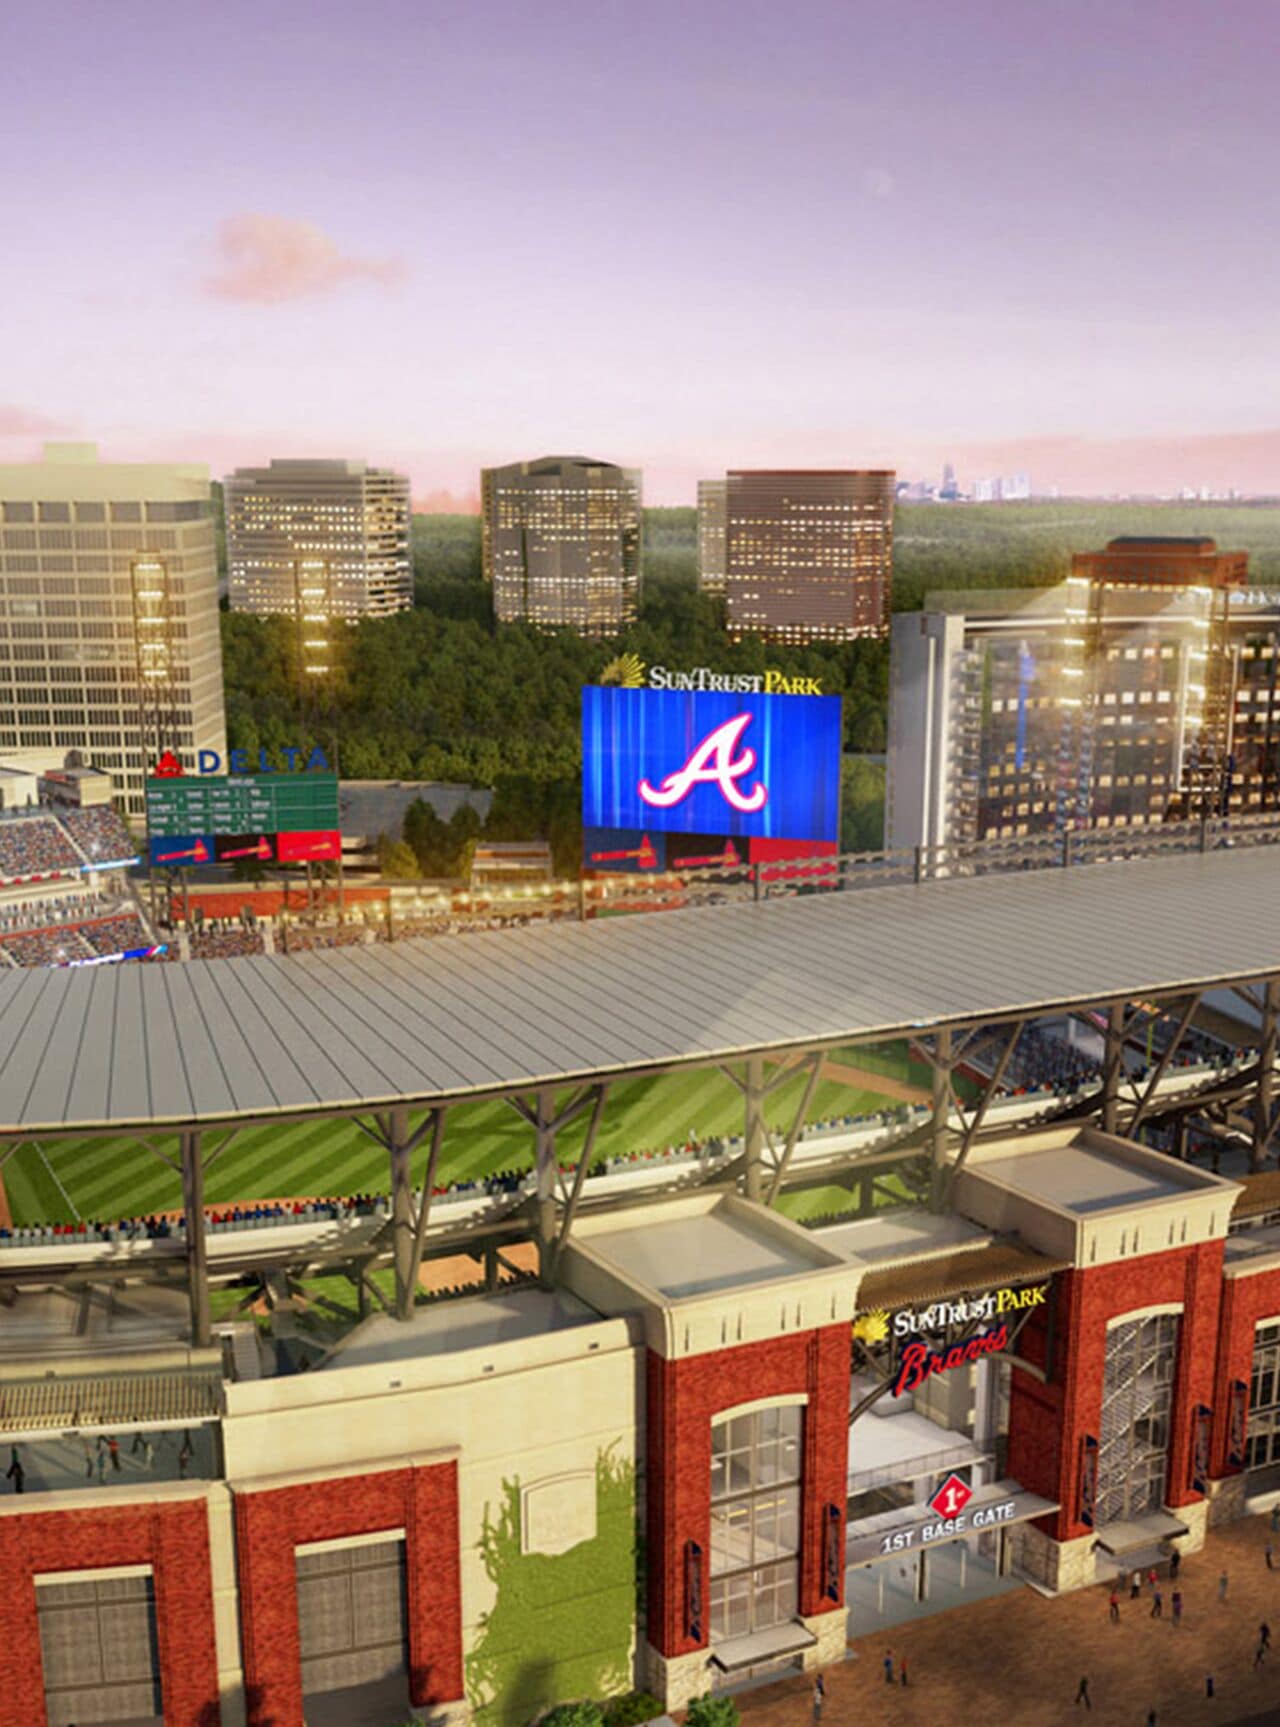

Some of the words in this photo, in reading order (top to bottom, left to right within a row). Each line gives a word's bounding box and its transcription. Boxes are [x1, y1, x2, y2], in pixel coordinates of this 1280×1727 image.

[198, 747, 328, 774] DELTA
[637, 712, 768, 813] A
[891, 1323, 1008, 1398] Braves
[882, 1531, 915, 1554] 1ST
[922, 1516, 966, 1542] BASE
[973, 1502, 1016, 1528] GATE
